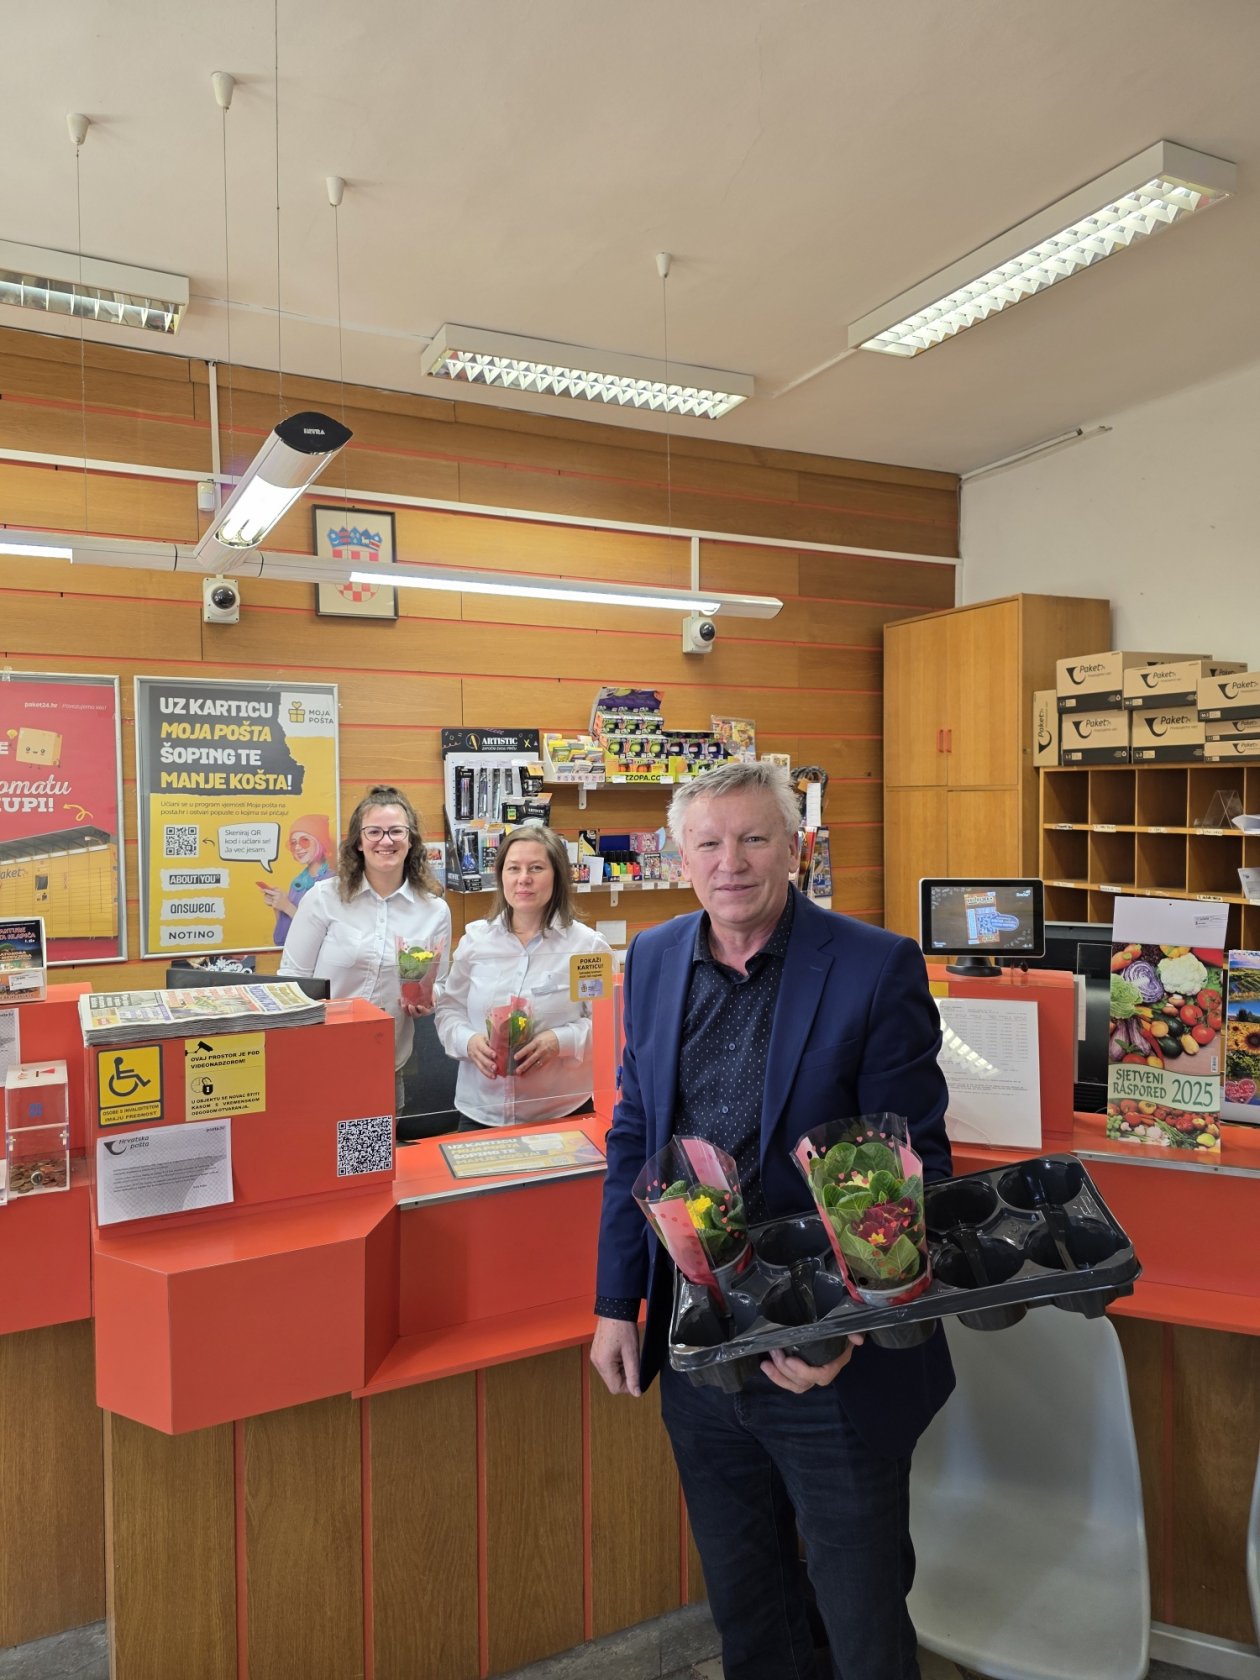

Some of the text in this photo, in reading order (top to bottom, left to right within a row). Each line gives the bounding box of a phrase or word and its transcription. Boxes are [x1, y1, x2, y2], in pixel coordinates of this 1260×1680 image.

[160, 697, 273, 719] UZ KARTICU
[309, 716, 335, 724] POŠTA
[161, 720, 273, 742] MOJA POŠTA
[482, 737, 518, 745] ARTISTIC
[160, 741, 262, 766] ŠOPING TE
[161, 769, 293, 791] MANJE KOŠTA!
[0, 797, 54, 813] UPI!
[225, 829, 249, 837] Skeniraj
[170, 875, 198, 884] ABOUT
[170, 902, 216, 914] answear.
[168, 931, 215, 940] NOTINO
[191, 1058, 246, 1069] VIDEONADZOROM!
[1115, 1068, 1163, 1085] SJETVENI
[1112, 1082, 1167, 1100] RASPORED
[1171, 1078, 1213, 1107] 2025
[105, 1111, 157, 1123] IMAJU PREDNOST
[118, 1135, 150, 1145] Hrvatska
[130, 1141, 150, 1150] pošta
